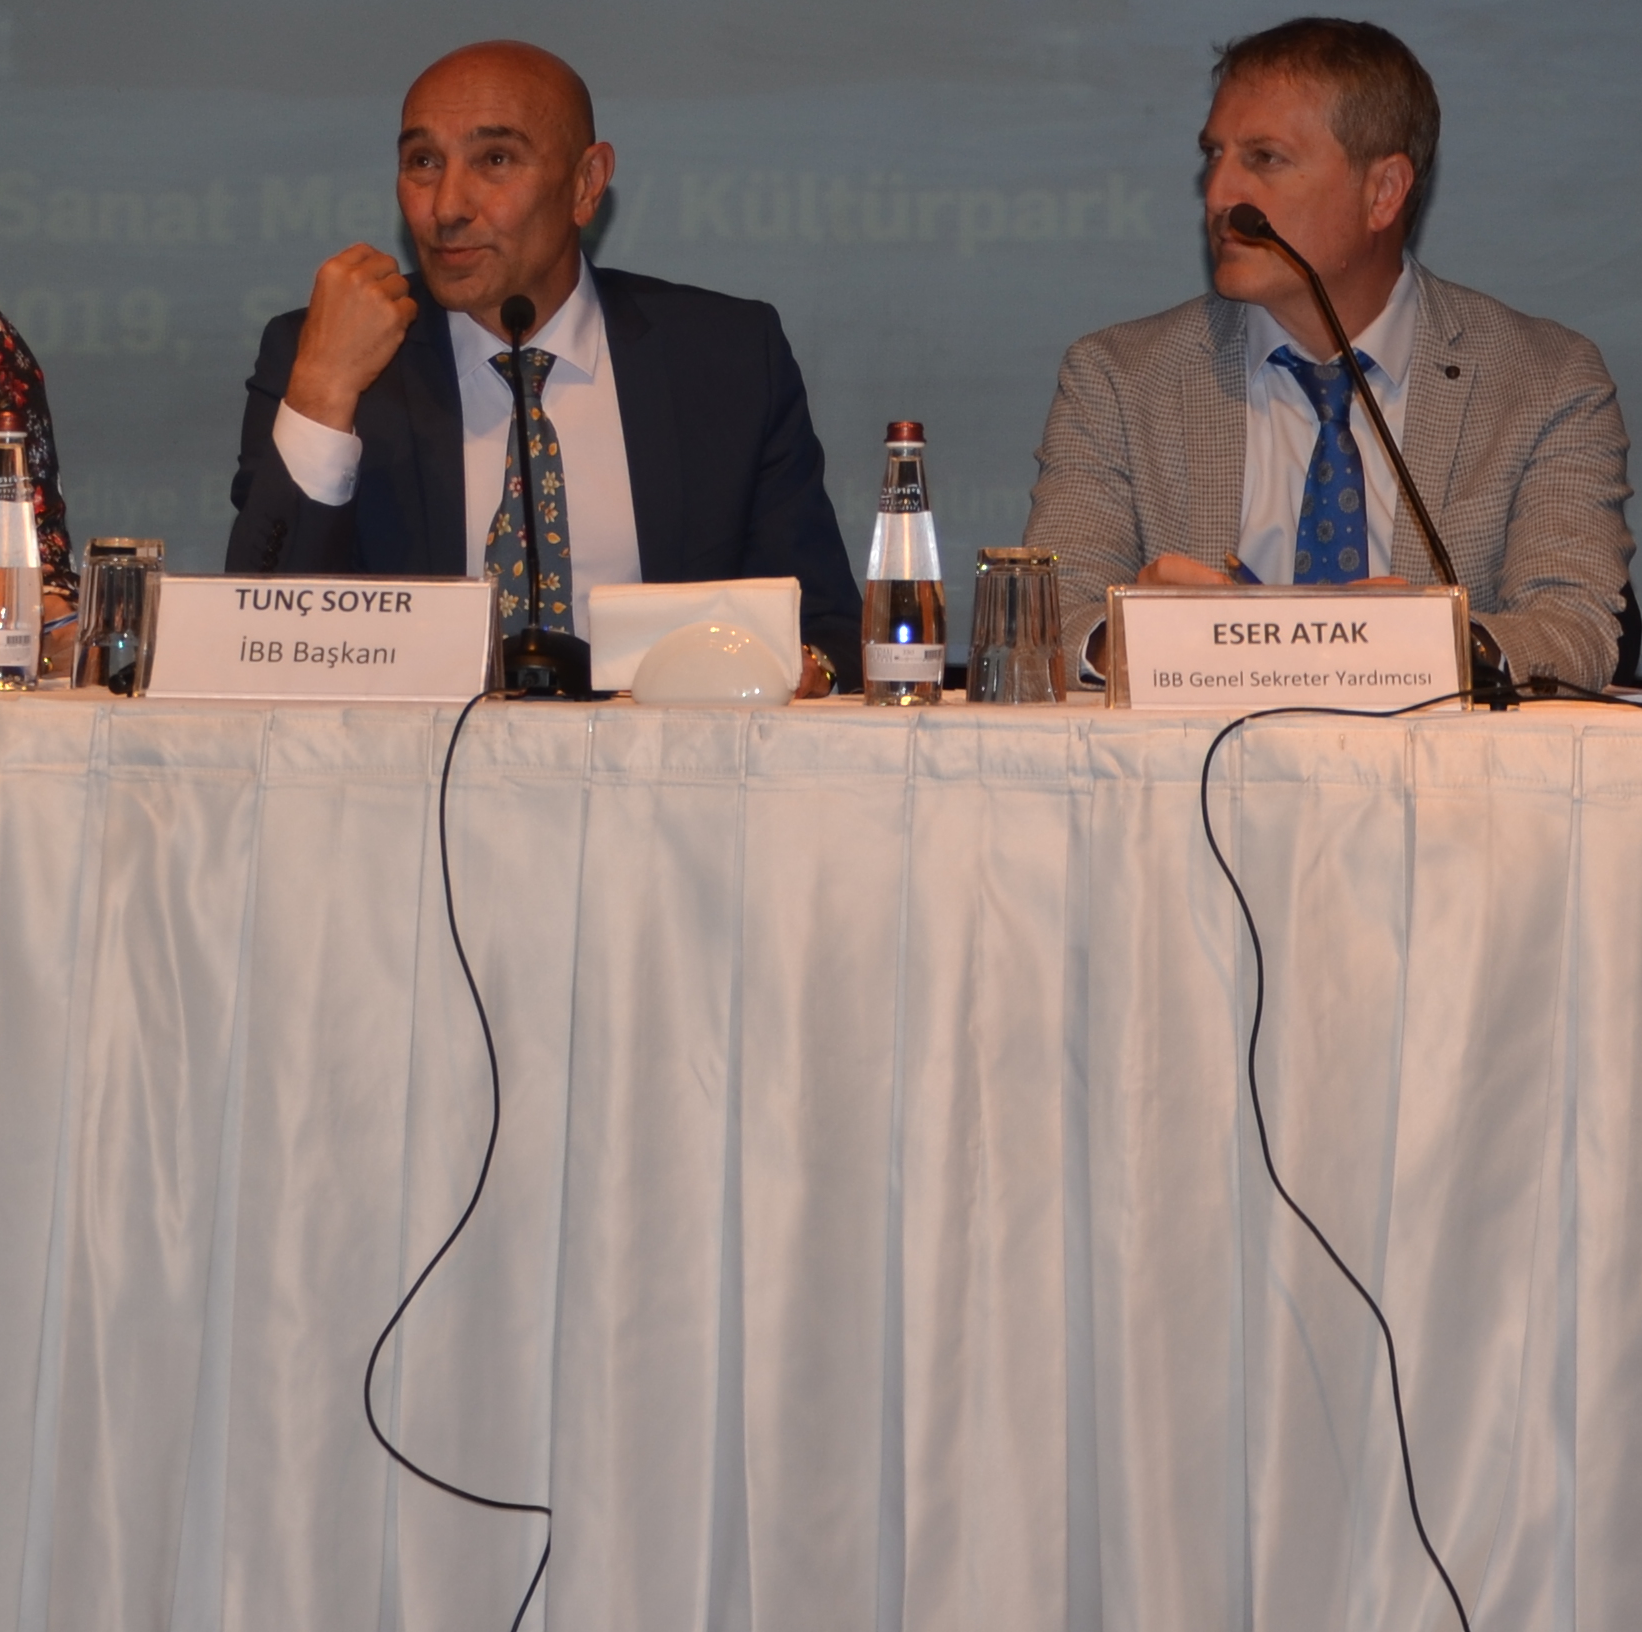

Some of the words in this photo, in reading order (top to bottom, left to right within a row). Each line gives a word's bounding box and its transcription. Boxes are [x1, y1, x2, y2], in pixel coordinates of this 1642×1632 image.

[678, 168, 1154, 259] Kültürpark
[235, 588, 313, 617] TUNÇ
[321, 590, 412, 614] SOYER
[1213, 622, 1282, 645] ESER
[1290, 622, 1368, 645] ATAK
[240, 635, 284, 663] İBB
[293, 640, 396, 669] Başkanı
[1153, 668, 1185, 688] İBB
[1189, 670, 1245, 689] Genel
[1249, 670, 1330, 689] Sekreter
[1335, 669, 1433, 688] Yardımcısı
